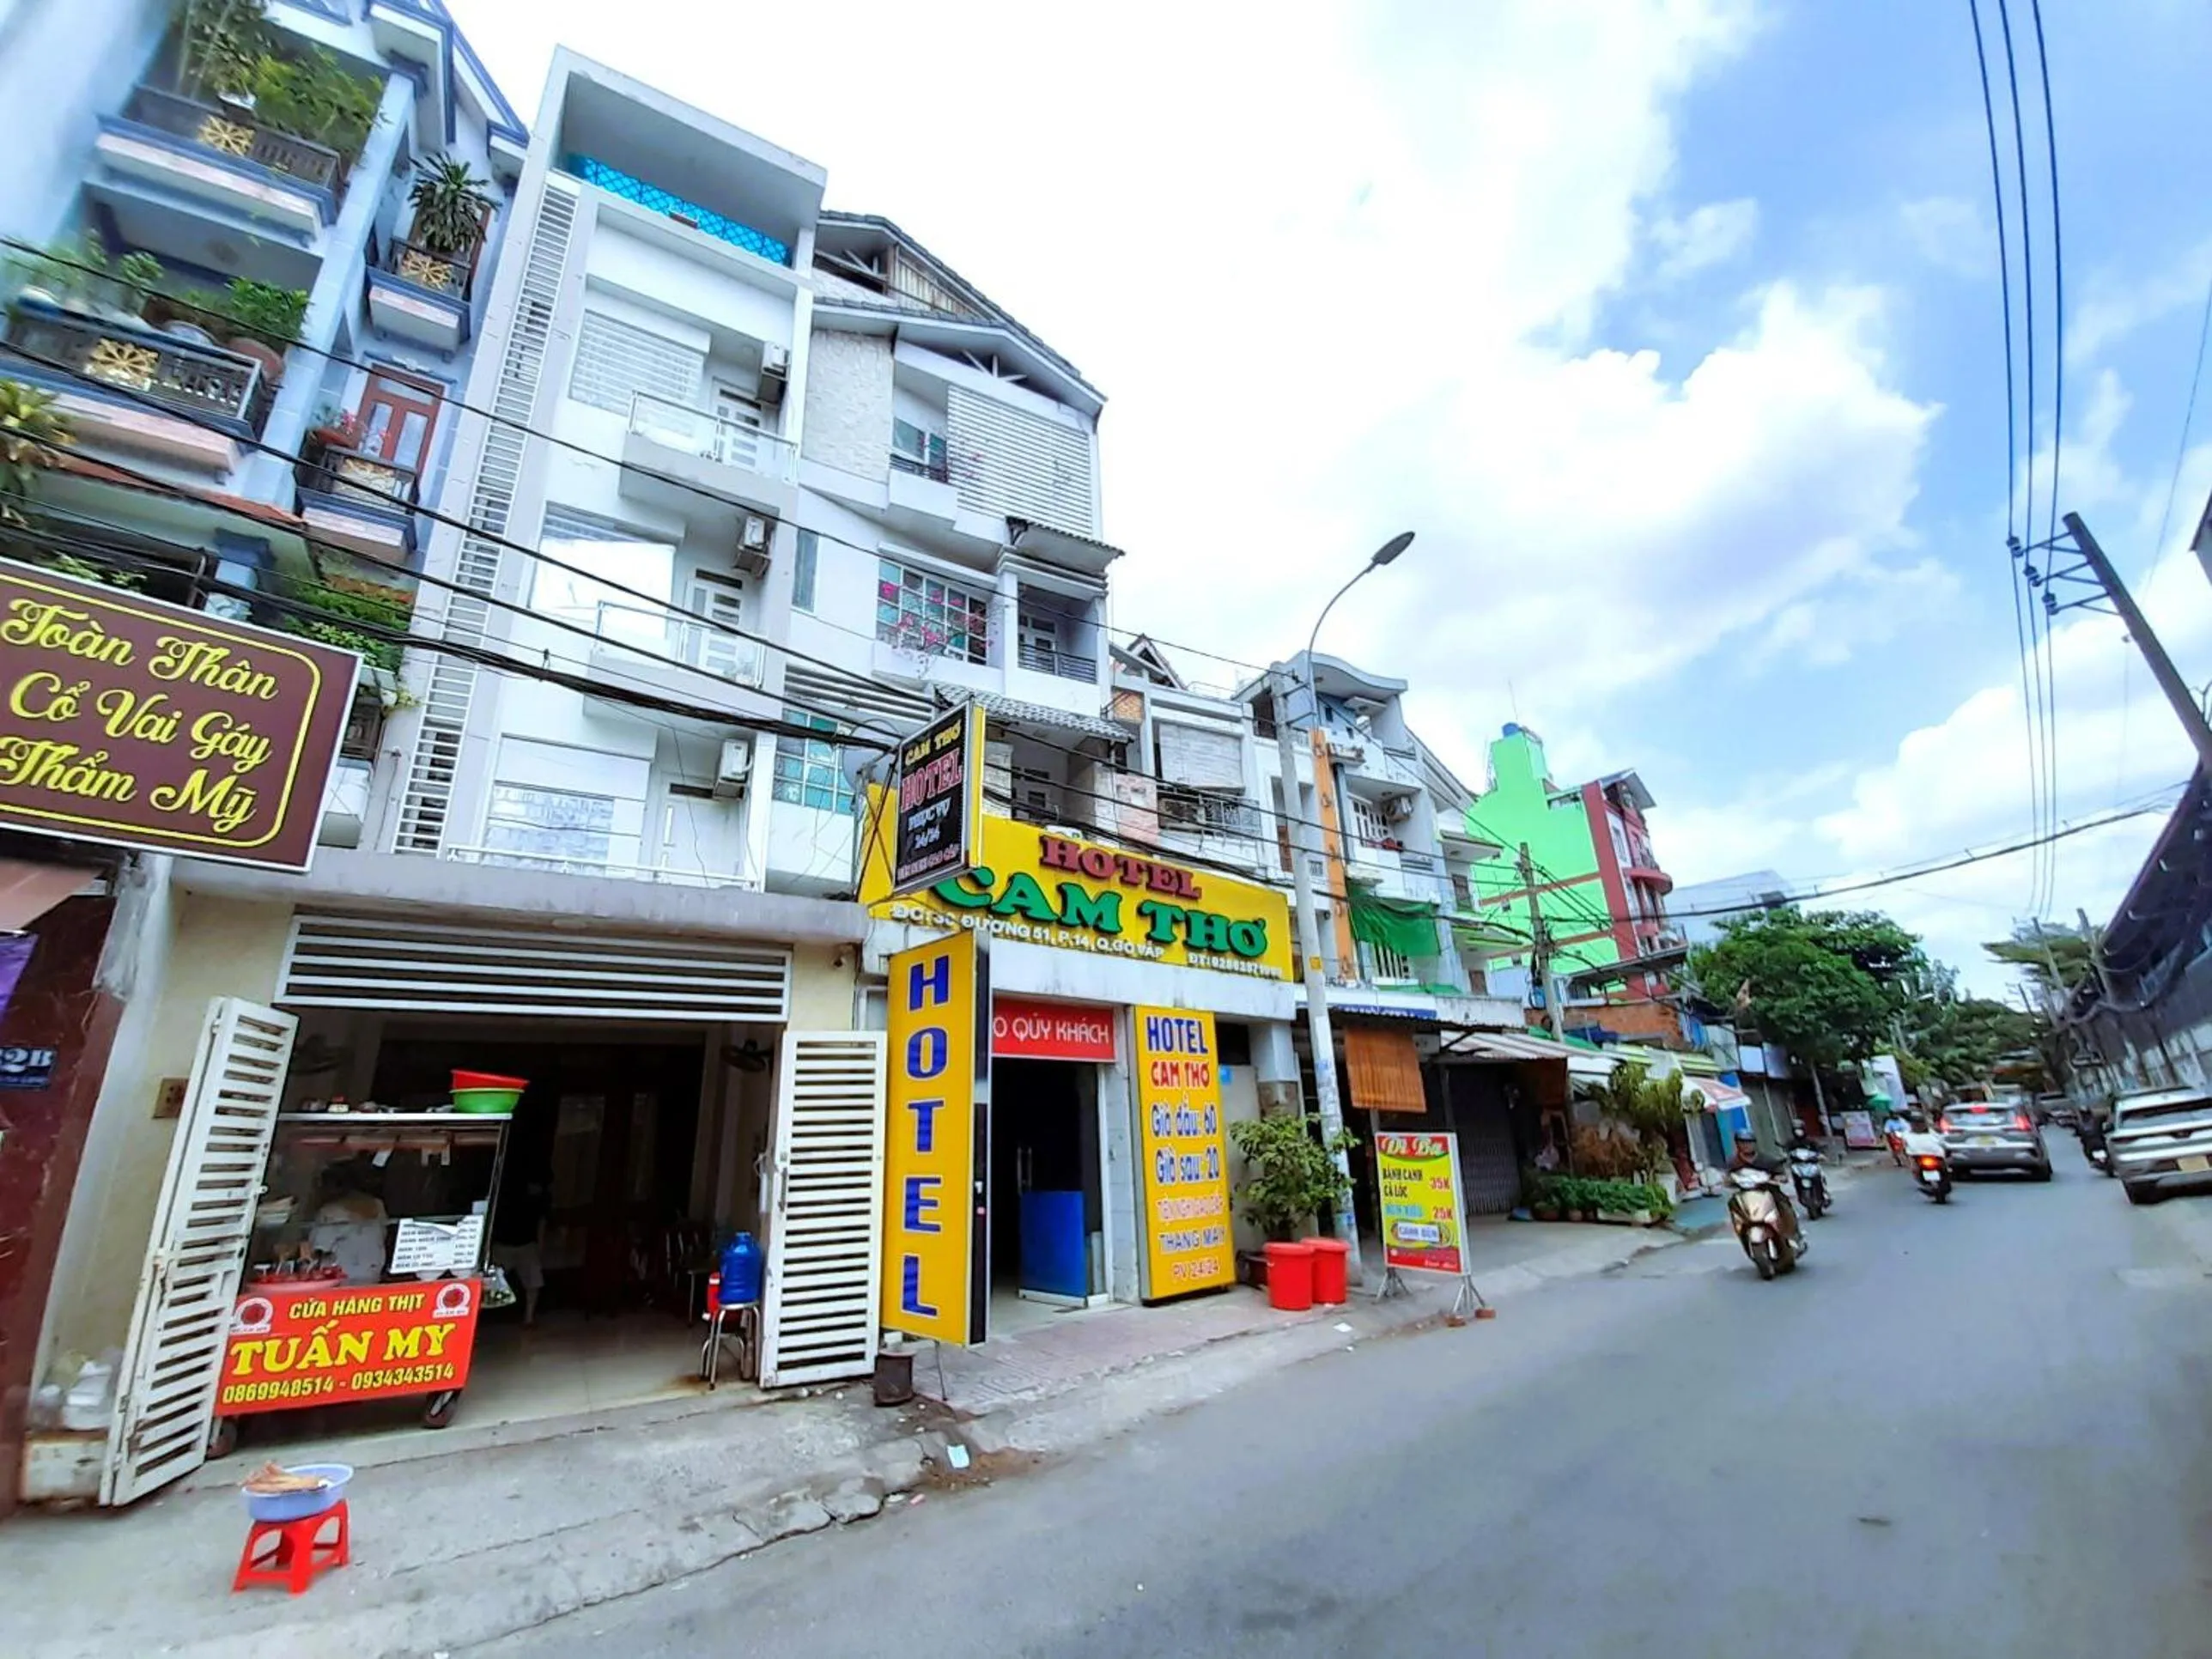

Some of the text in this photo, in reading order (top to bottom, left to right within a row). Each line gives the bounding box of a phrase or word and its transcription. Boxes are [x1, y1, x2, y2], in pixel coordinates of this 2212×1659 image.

[1, 599, 278, 700] Toàn Thân
[10, 672, 91, 721] Cổ
[96, 690, 182, 744] Vai
[0, 736, 258, 832] Thẩm Mỹ
[901, 747, 963, 813] HOTEL
[1039, 835, 1200, 900] HOTEL
[931, 866, 1267, 957] CAM THƠ
[961, 913, 1030, 938] ĐƯỜNG
[1055, 1017, 1109, 1043] KHÁCH
[1146, 1016, 1208, 1054] HOTEL
[1151, 1060, 1211, 1088] CAM THƠ
[901, 954, 950, 1319] HOTEL
[289, 1293, 425, 1320] CỬA HÀNG THỊT
[229, 1320, 457, 1376] TUẤN MY
[351, 1364, 454, 1391] 0934343514
